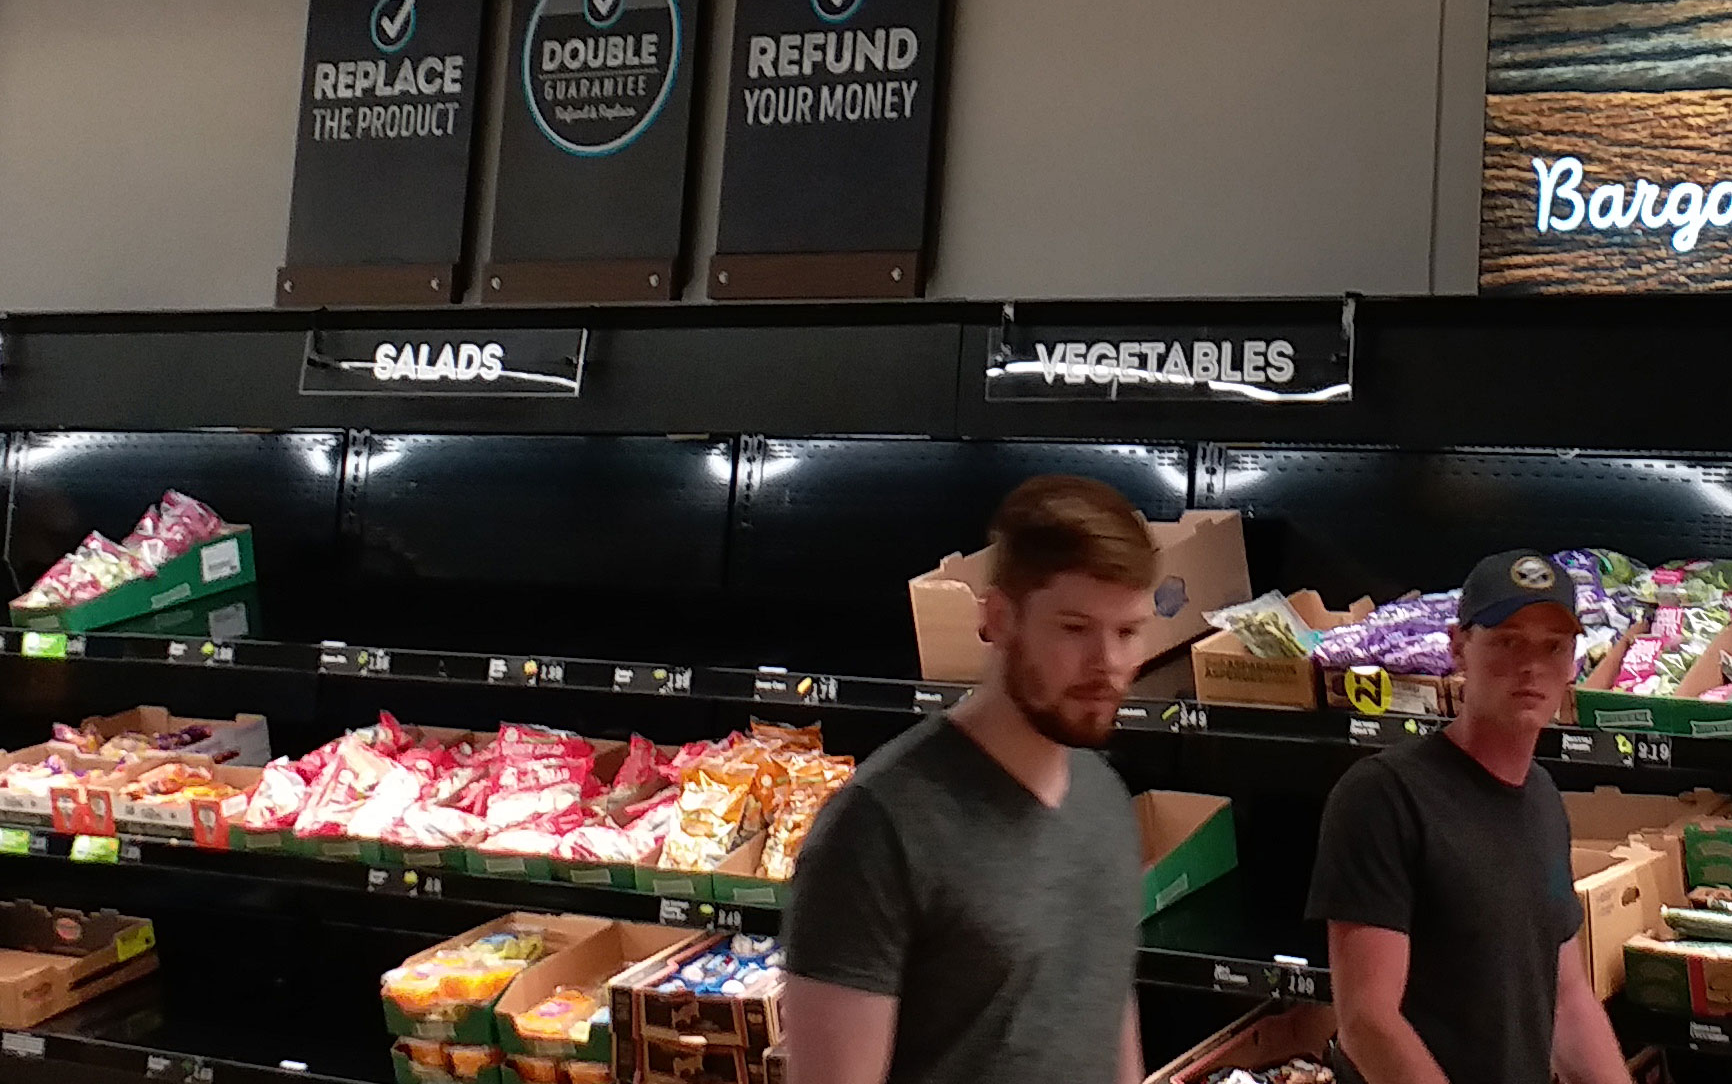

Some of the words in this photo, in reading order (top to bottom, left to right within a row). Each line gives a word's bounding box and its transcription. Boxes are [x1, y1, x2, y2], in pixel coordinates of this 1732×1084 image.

[542, 33, 659, 72] DOUBLE
[748, 27, 918, 80] REFUND
[313, 55, 464, 101] REPLACE
[544, 74, 647, 102] GUARANTEE
[312, 107, 354, 142] THE
[355, 102, 460, 140] PRODUCT
[743, 85, 812, 126] YOUR
[818, 80, 919, 122] MONEY
[373, 342, 505, 382] SALADS
[1034, 339, 1296, 386] VEGETABLES
